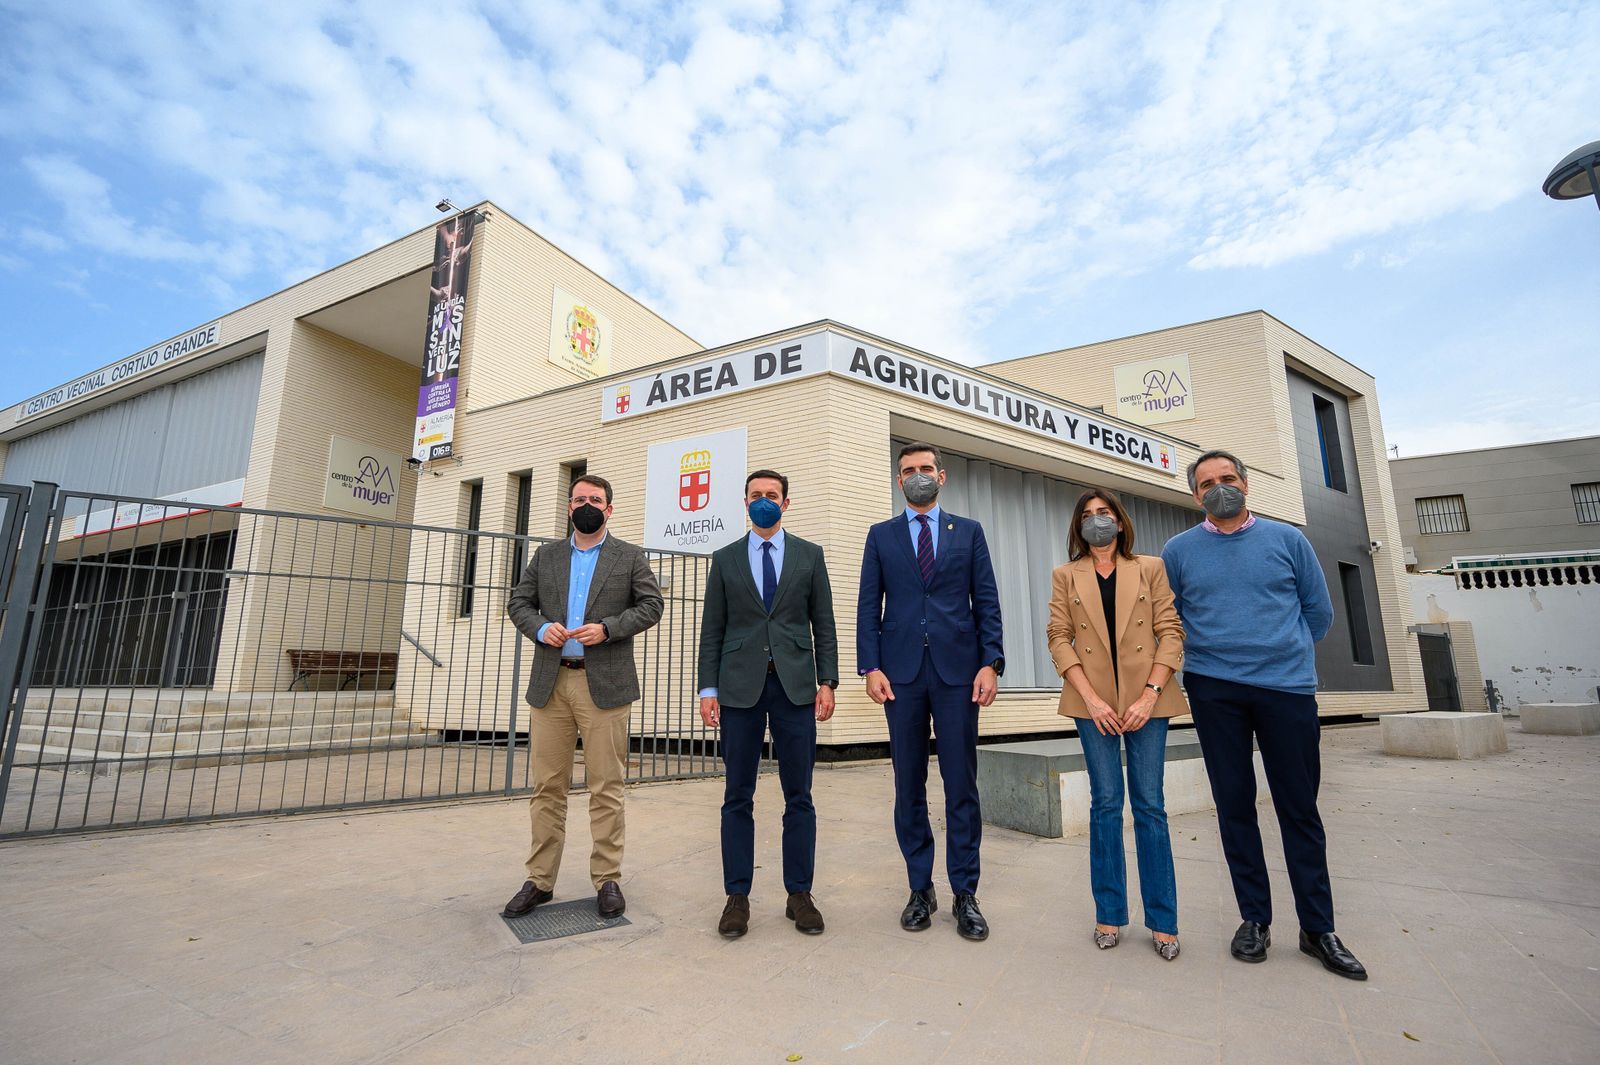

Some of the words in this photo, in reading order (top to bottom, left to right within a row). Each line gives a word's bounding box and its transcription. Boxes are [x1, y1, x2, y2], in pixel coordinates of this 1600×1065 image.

[429, 323, 462, 349] SIN
[448, 341, 461, 352] LA
[27, 389, 64, 414] CENTRO
[67, 375, 106, 398] VECINAL
[111, 351, 158, 381] CORTIJO
[163, 327, 216, 360] GRANDE
[427, 350, 460, 378] LUZ
[646, 361, 739, 407] ÁREA
[754, 344, 802, 381] DE
[849, 347, 1057, 434] AGRICULTURA
[1064, 415, 1079, 439] Y
[1088, 423, 1153, 463] PESCA
[1120, 394, 1142, 404] centro
[1144, 394, 1188, 412] mujer
[432, 446, 445, 457] 016
[331, 472, 354, 483] centro
[353, 486, 395, 506] mujer
[664, 515, 725, 538] ALMERÍA
[677, 534, 710, 546] CIUDAD
